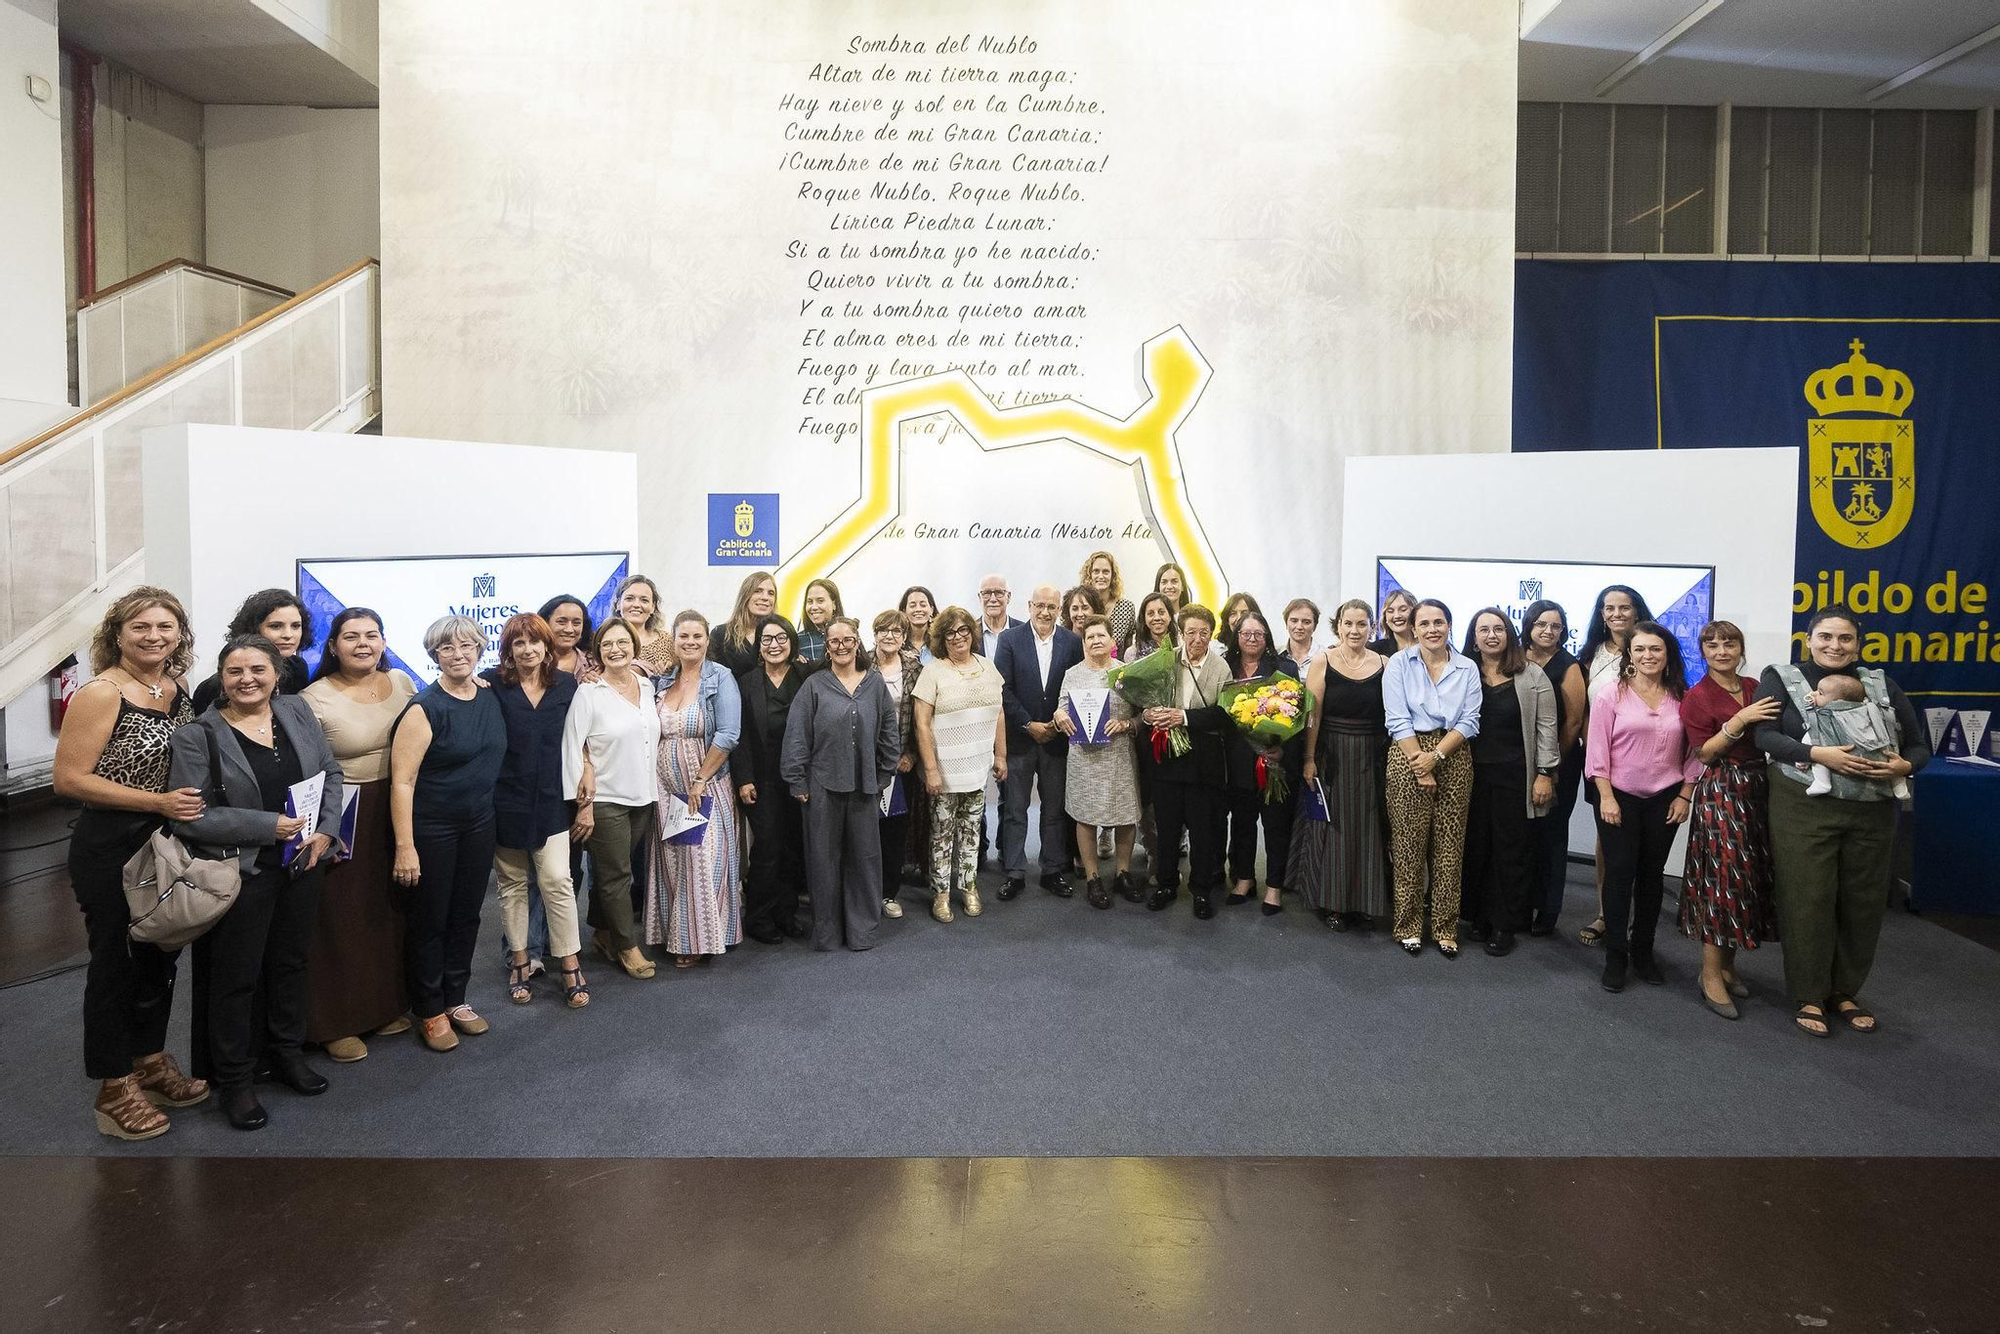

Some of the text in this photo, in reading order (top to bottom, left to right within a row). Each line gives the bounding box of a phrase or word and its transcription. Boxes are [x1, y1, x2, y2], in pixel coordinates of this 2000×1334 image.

[847, 33, 1038, 54] Sombra del Nublo
[808, 63, 863, 85] Altar
[872, 63, 896, 81] de
[905, 69, 931, 83] mi
[941, 65, 1000, 86] tierra
[779, 93, 819, 120] Hay
[829, 98, 883, 113] nieve
[890, 100, 904, 120] y
[915, 95, 945, 117] sol
[953, 99, 976, 112] en
[986, 94, 1007, 115] la
[785, 122, 866, 142] Cumbre
[874, 121, 898, 141] de
[908, 128, 937, 142] mi
[944, 123, 997, 142] Gran
[779, 151, 1109, 173] ¡Cumbre de mi Gran Canaria!
[798, 181, 861, 207] Roque
[948, 182, 1012, 206] Roque
[831, 213, 894, 231] Lírica
[904, 211, 975, 231] Piedra
[784, 240, 808, 258] Si
[818, 247, 831, 259] a
[840, 243, 860, 259] tu
[870, 240, 946, 260] sombra
[953, 242, 977, 268] yo
[987, 240, 1012, 260] he
[807, 270, 875, 291] Quiero
[887, 274, 932, 289] vivir
[942, 276, 954, 288] a
[963, 271, 984, 288] tu
[800, 299, 1086, 323] Y a tu sombra quiero amar
[802, 329, 825, 347] El
[834, 328, 886, 349] alma
[896, 333, 938, 347] eres
[947, 329, 970, 347] de
[979, 331, 1005, 347] mi
[798, 358, 858, 386] Fuego
[865, 362, 880, 385] y
[890, 358, 936, 376] lava
[1008, 359, 1030, 376] al
[802, 387, 826, 405] El
[798, 416, 859, 444] Fuego
[914, 522, 960, 539] Gran
[968, 522, 1042, 540] Canaria
[1050, 522, 1114, 540] (Néstor
[715, 548, 772, 557] Gran Canaria
[719, 539, 767, 548] Cabildo de
[1925, 570, 1988, 614] de
[449, 604, 519, 622] Mujeres
